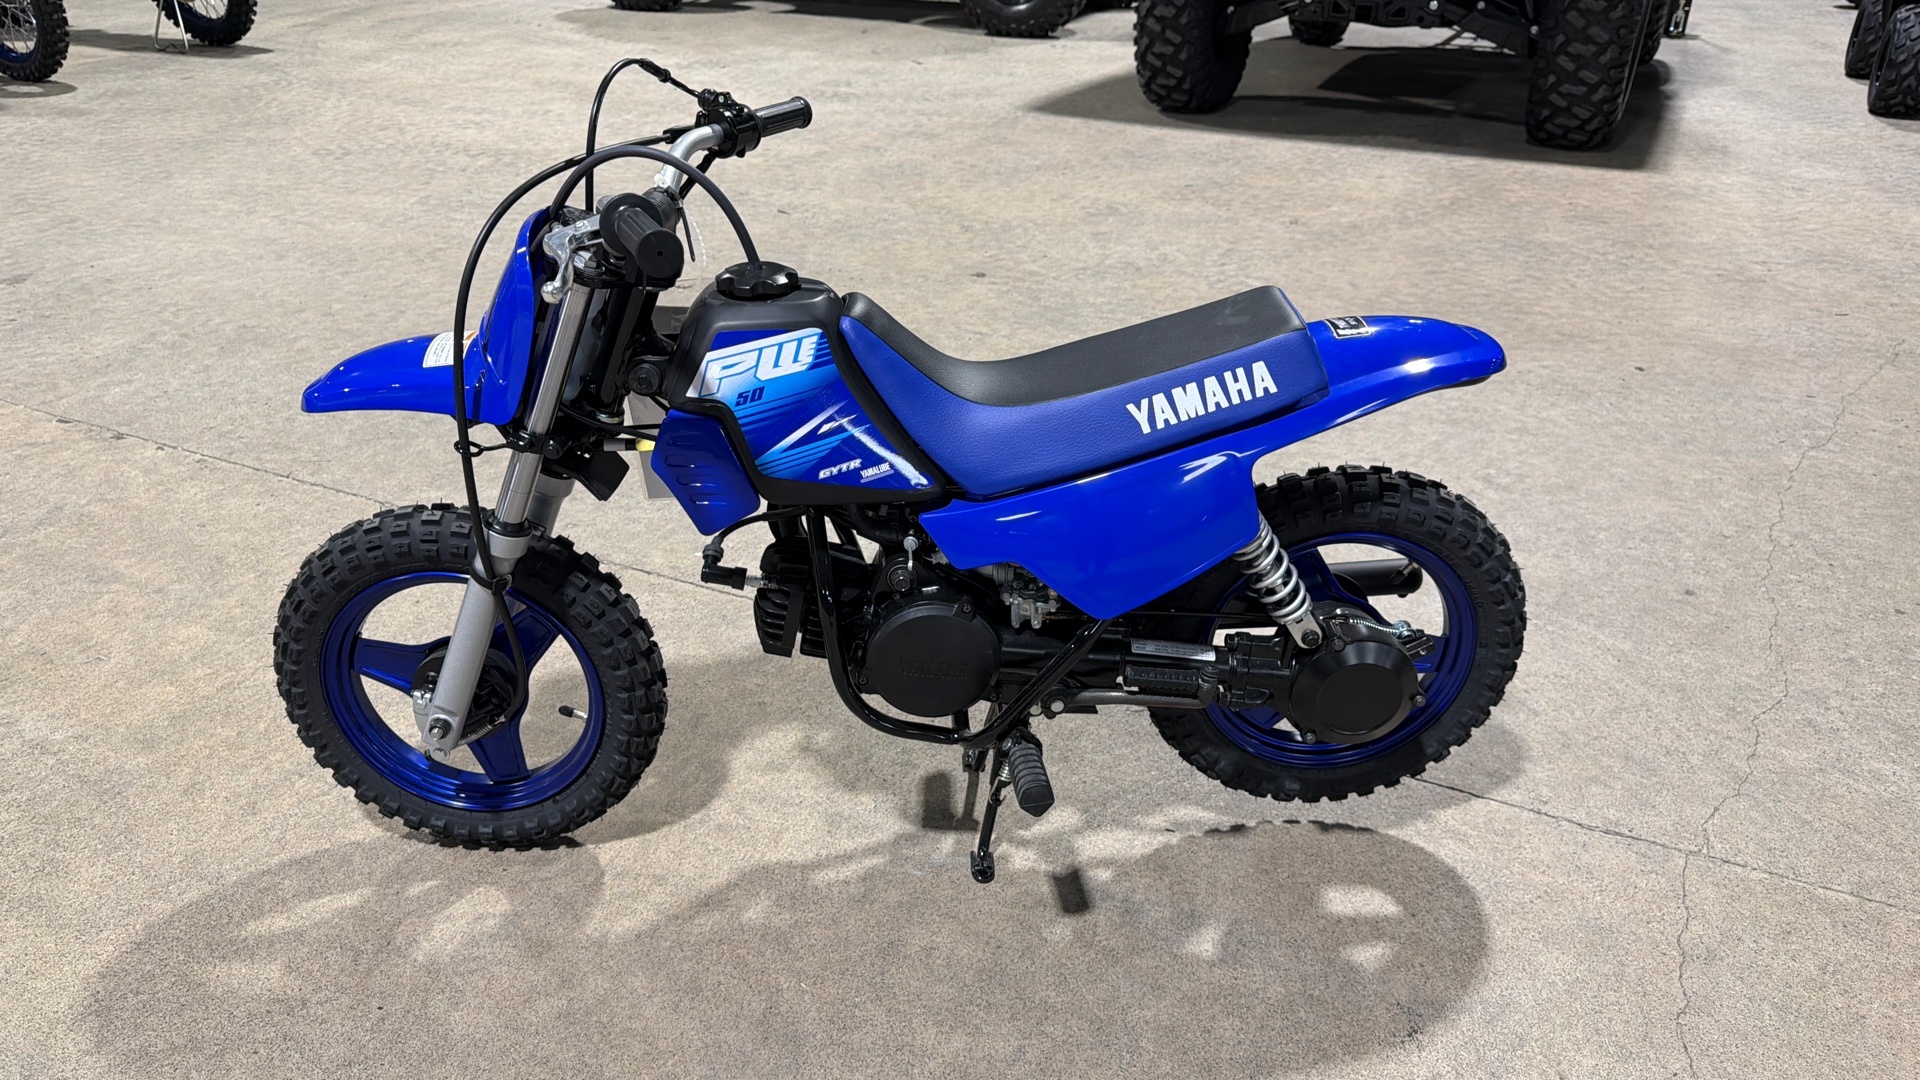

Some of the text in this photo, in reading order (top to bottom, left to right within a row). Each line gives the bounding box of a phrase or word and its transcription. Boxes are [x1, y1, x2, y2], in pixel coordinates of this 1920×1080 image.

[700, 333, 820, 398] PW
[735, 386, 765, 407] 50
[1125, 361, 1278, 434] YAMAHA
[818, 458, 862, 479] GYTR
[860, 462, 891, 478] YAMALUBE
